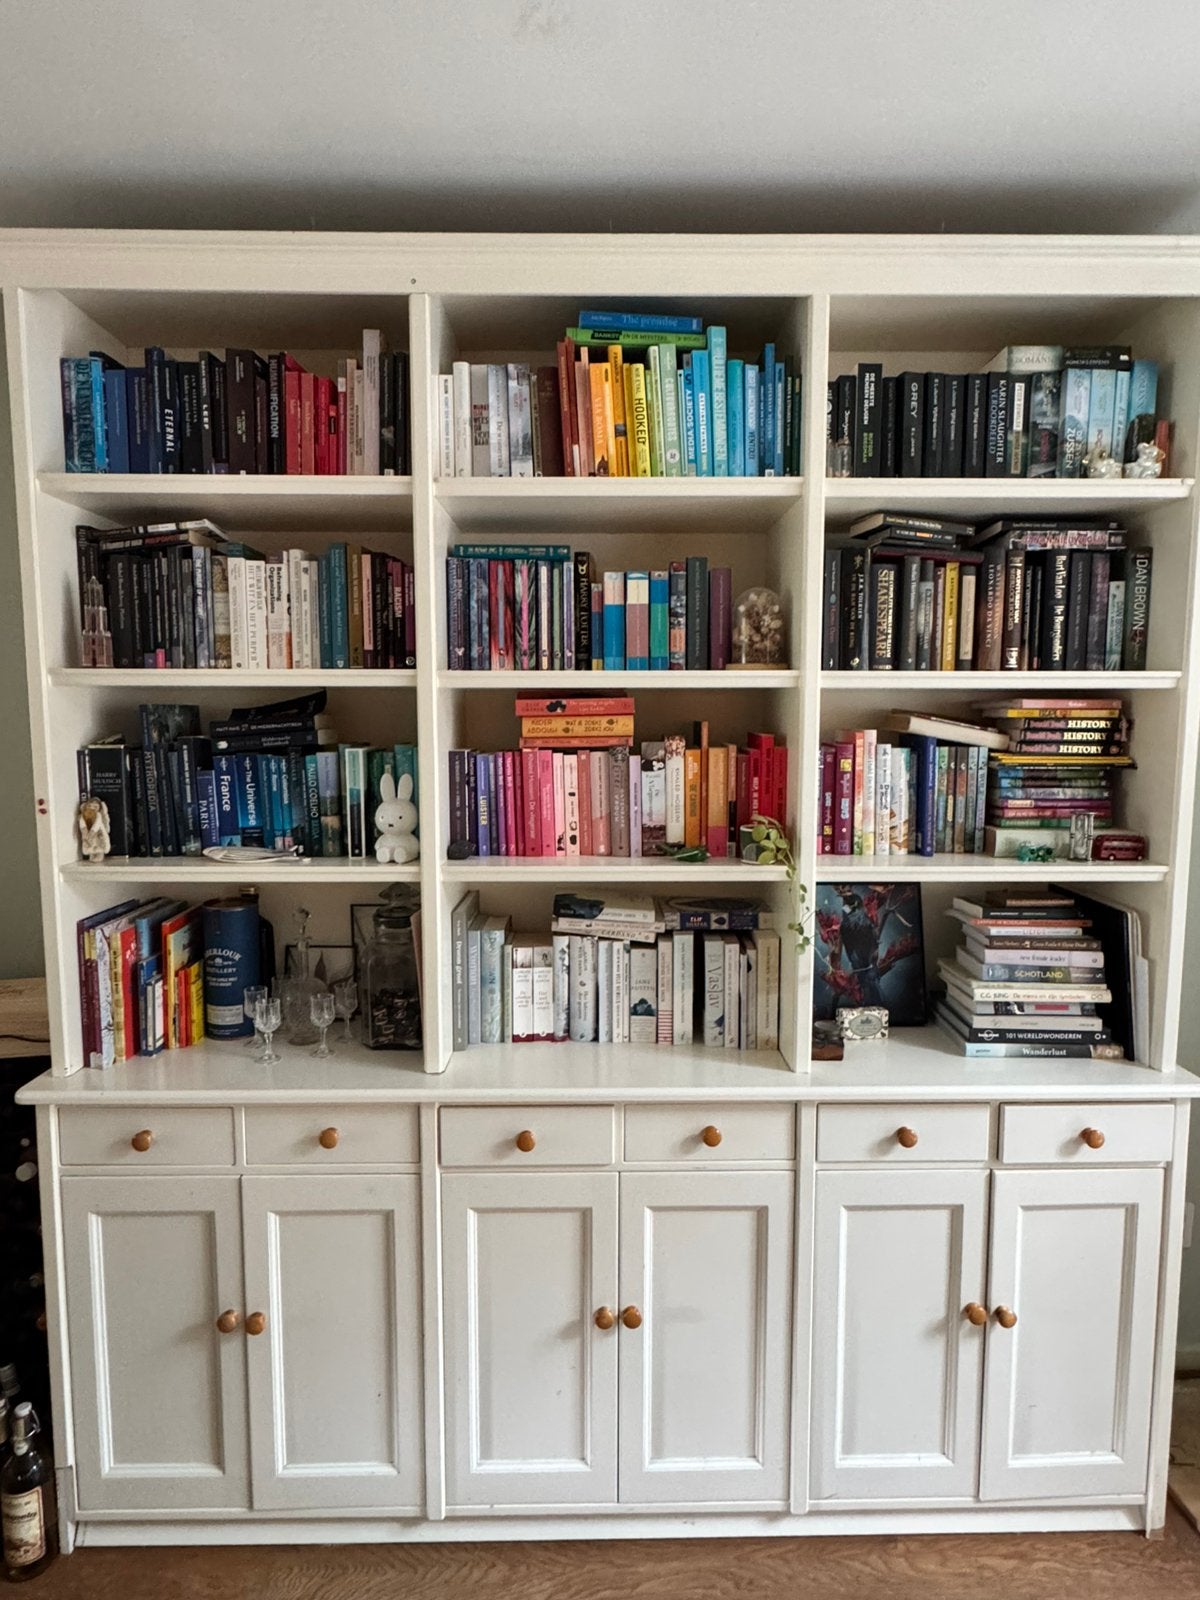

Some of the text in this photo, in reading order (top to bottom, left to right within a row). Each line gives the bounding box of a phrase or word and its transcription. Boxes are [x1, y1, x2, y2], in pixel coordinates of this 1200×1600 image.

[870, 373, 875, 381] DE
[270, 360, 279, 438] HUMANIFICATION
[165, 409, 174, 452] ETERNAL
[634, 398, 646, 444] HOOKED
[996, 380, 1006, 463] KARIN SLAUGHTER
[1065, 428, 1075, 468] ZUSSEN
[1055, 572, 1066, 585] Van
[1056, 556, 1067, 571] Bart
[249, 600, 256, 610] EN
[394, 587, 402, 617] RACISM
[1055, 586, 1065, 598] Loo
[1133, 559, 1148, 630] DAN BROWN
[580, 578, 589, 646] HARRY POTTER
[875, 569, 889, 658] SHAKESPEARE
[986, 611, 992, 621] DA
[1055, 605, 1064, 615] De
[1063, 732, 1106, 740] HISTORY
[1068, 720, 1112, 728] HISTORY
[1059, 746, 1104, 754] HISTORY
[144, 752, 156, 812] MYTHOPEDIA
[308, 764, 317, 787] PAULO
[220, 775, 231, 811] France
[246, 783, 257, 825] Universe
[309, 788, 319, 818] COELHO
[529, 802, 535, 811] De
[199, 800, 208, 829] PARIS
[209, 803, 217, 842] ARCHITECTURE
[708, 966, 722, 1008] Vaslav
[1022, 1047, 1067, 1056] Wanderlust
